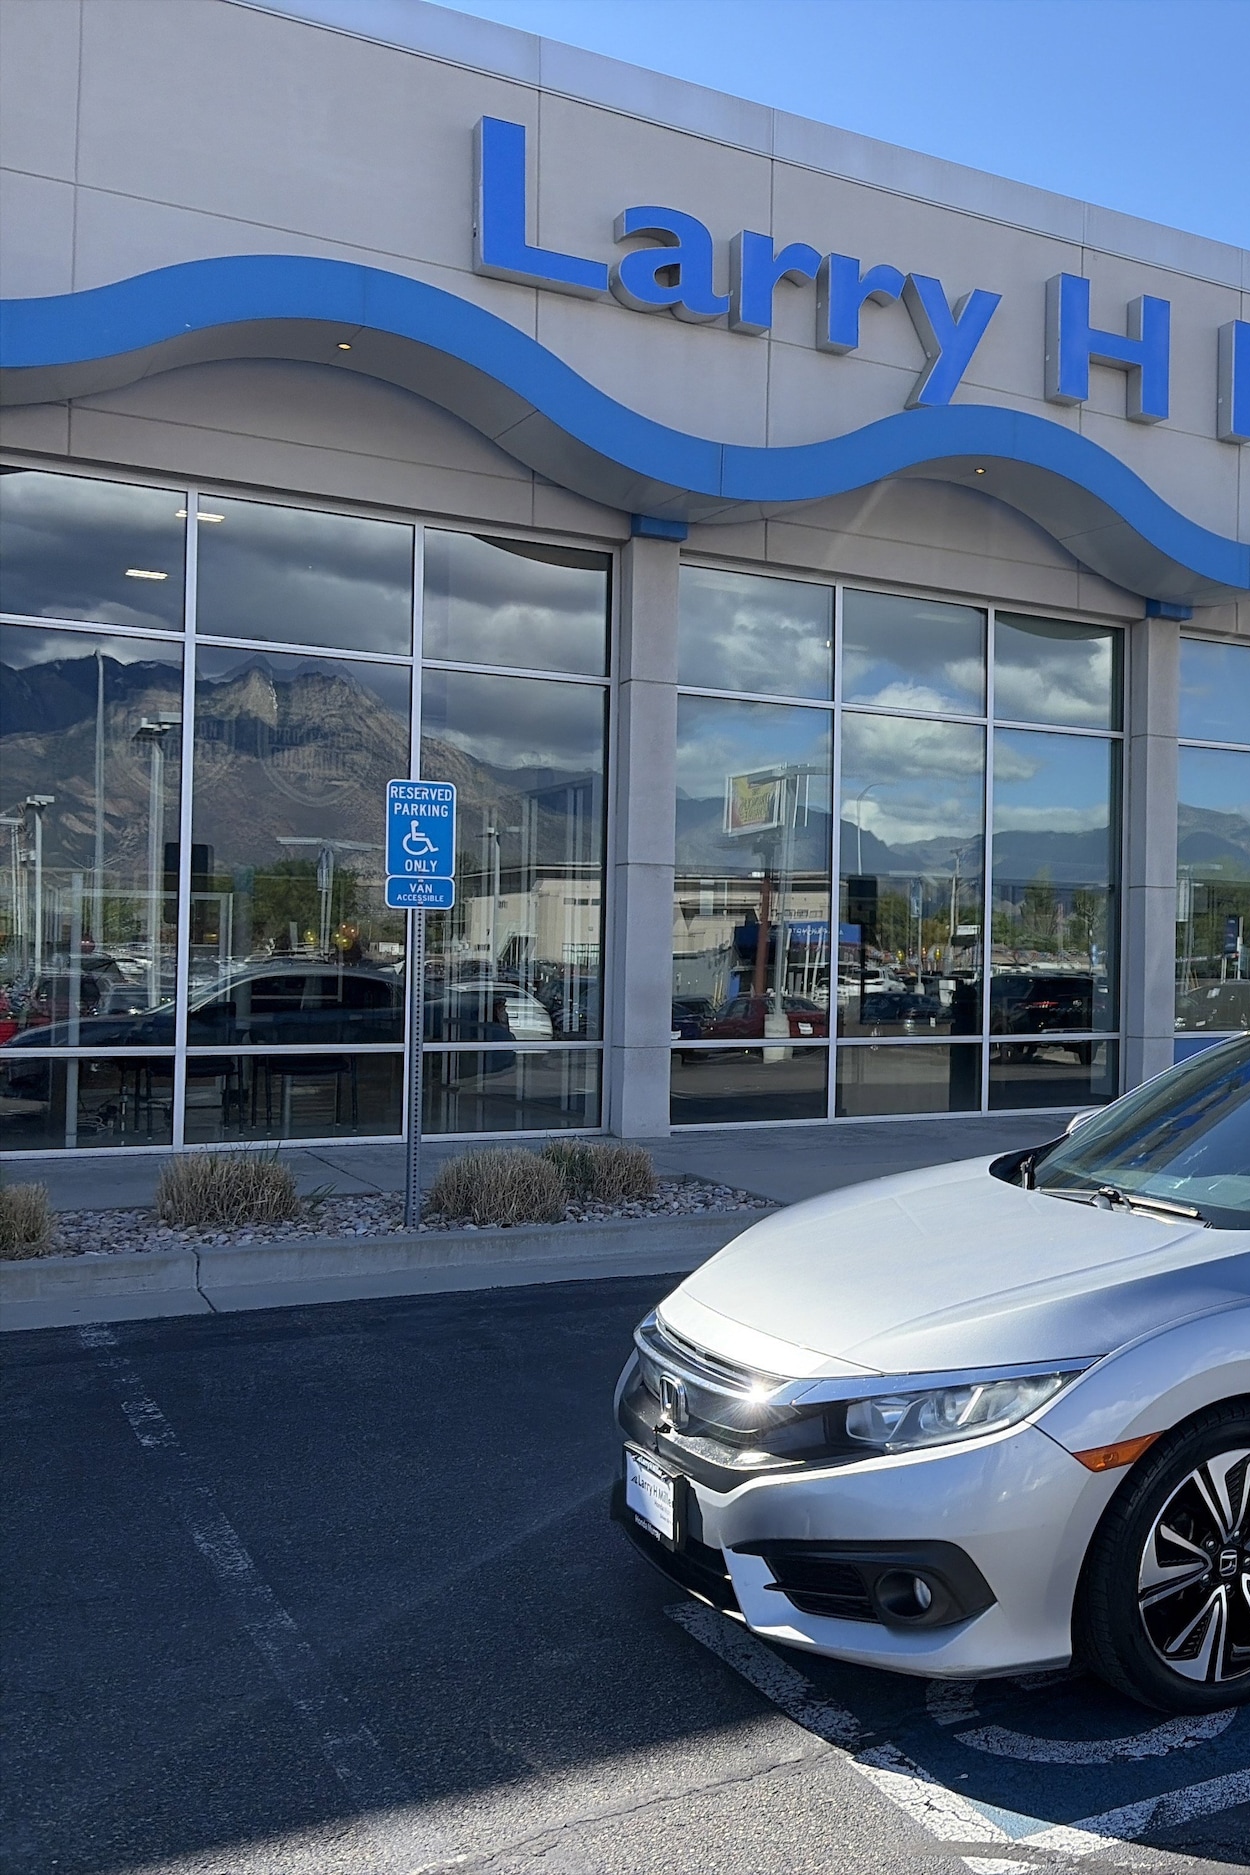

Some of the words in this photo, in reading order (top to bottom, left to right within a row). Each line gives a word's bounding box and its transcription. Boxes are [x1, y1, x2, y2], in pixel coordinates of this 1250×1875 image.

[473, 115, 1002, 409] Larry
[1045, 272, 1170, 424] H
[390, 785, 453, 801] RESERVED
[394, 802, 449, 817] PARKING
[404, 859, 438, 873] ONLY
[409, 883, 433, 893] VAN
[396, 894, 444, 902] ACCESSIBLE
[638, 1474, 652, 1497] Larry
[653, 1484, 658, 1498] H
